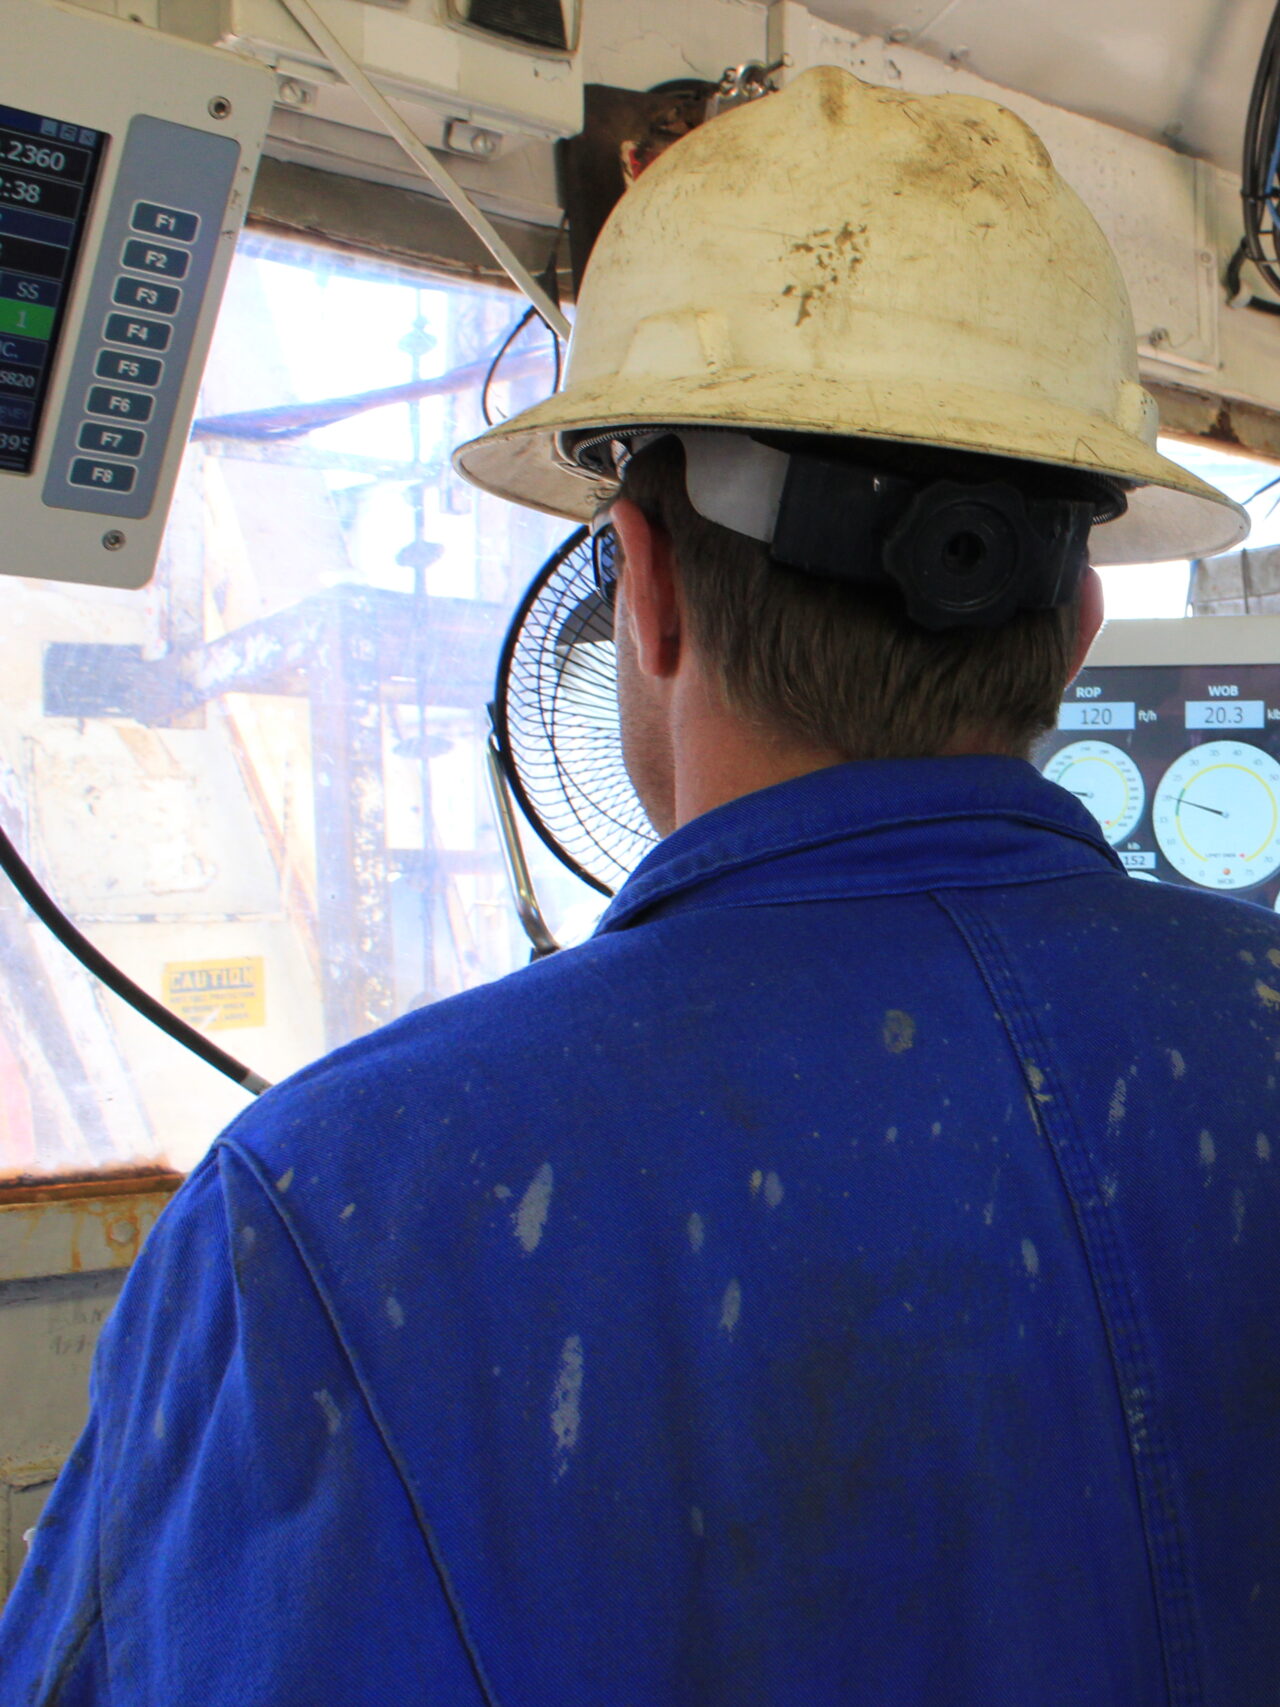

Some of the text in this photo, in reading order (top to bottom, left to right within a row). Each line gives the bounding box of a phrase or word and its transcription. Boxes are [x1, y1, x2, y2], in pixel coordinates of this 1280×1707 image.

[156, 213, 176, 232] F1
[145, 250, 168, 268] F2
[16, 281, 40, 299] SS
[136, 287, 158, 305] F3
[16, 310, 27, 329] 1
[126, 324, 149, 341] F4
[117, 360, 140, 377] F5
[108, 396, 131, 412] F6
[100, 432, 123, 448] F7
[91, 467, 114, 483] F8
[1076, 687, 1101, 698] ROP
[1208, 685, 1239, 697] WOB
[1081, 708, 1157, 725] 120 ft/h
[1204, 706, 1244, 724] 20.3
[170, 966, 254, 993] CAUTION
